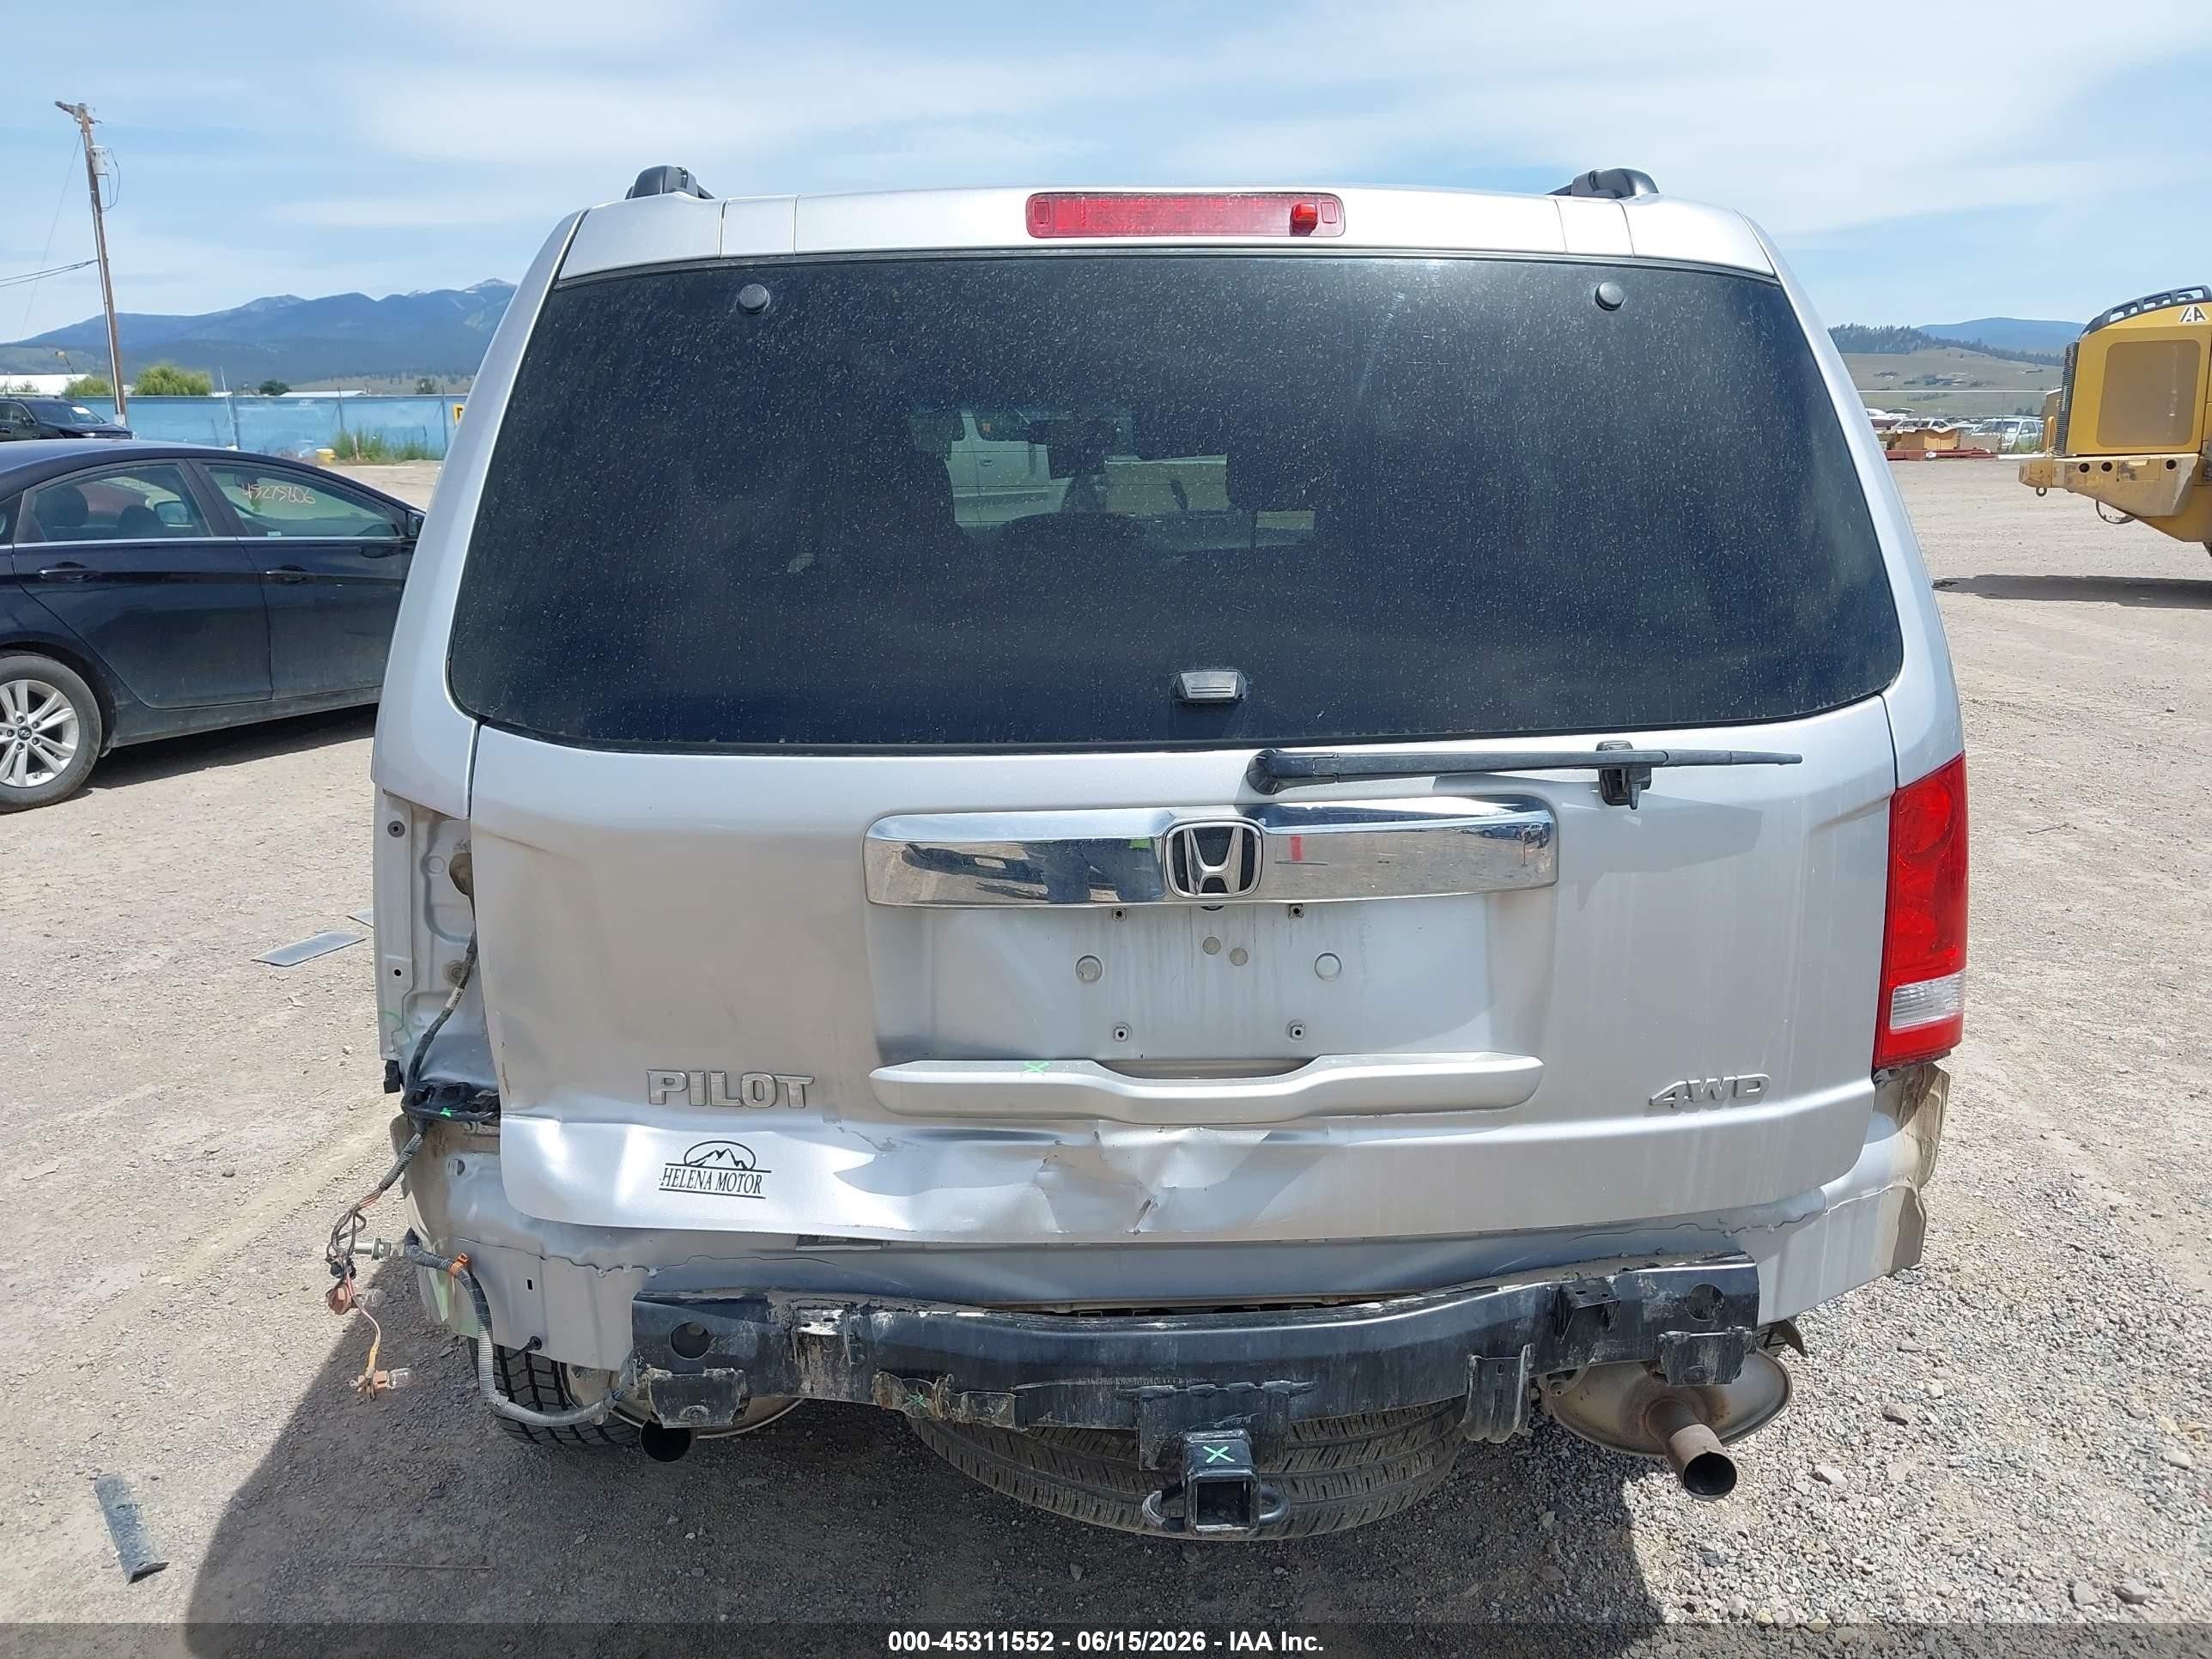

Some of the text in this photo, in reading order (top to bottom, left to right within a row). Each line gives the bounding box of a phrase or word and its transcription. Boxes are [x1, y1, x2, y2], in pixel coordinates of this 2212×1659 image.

[646, 1069, 815, 1109] PILOT
[1648, 1073, 1771, 1109] 4WD
[660, 1167, 763, 1194] HELENA MOTOR
